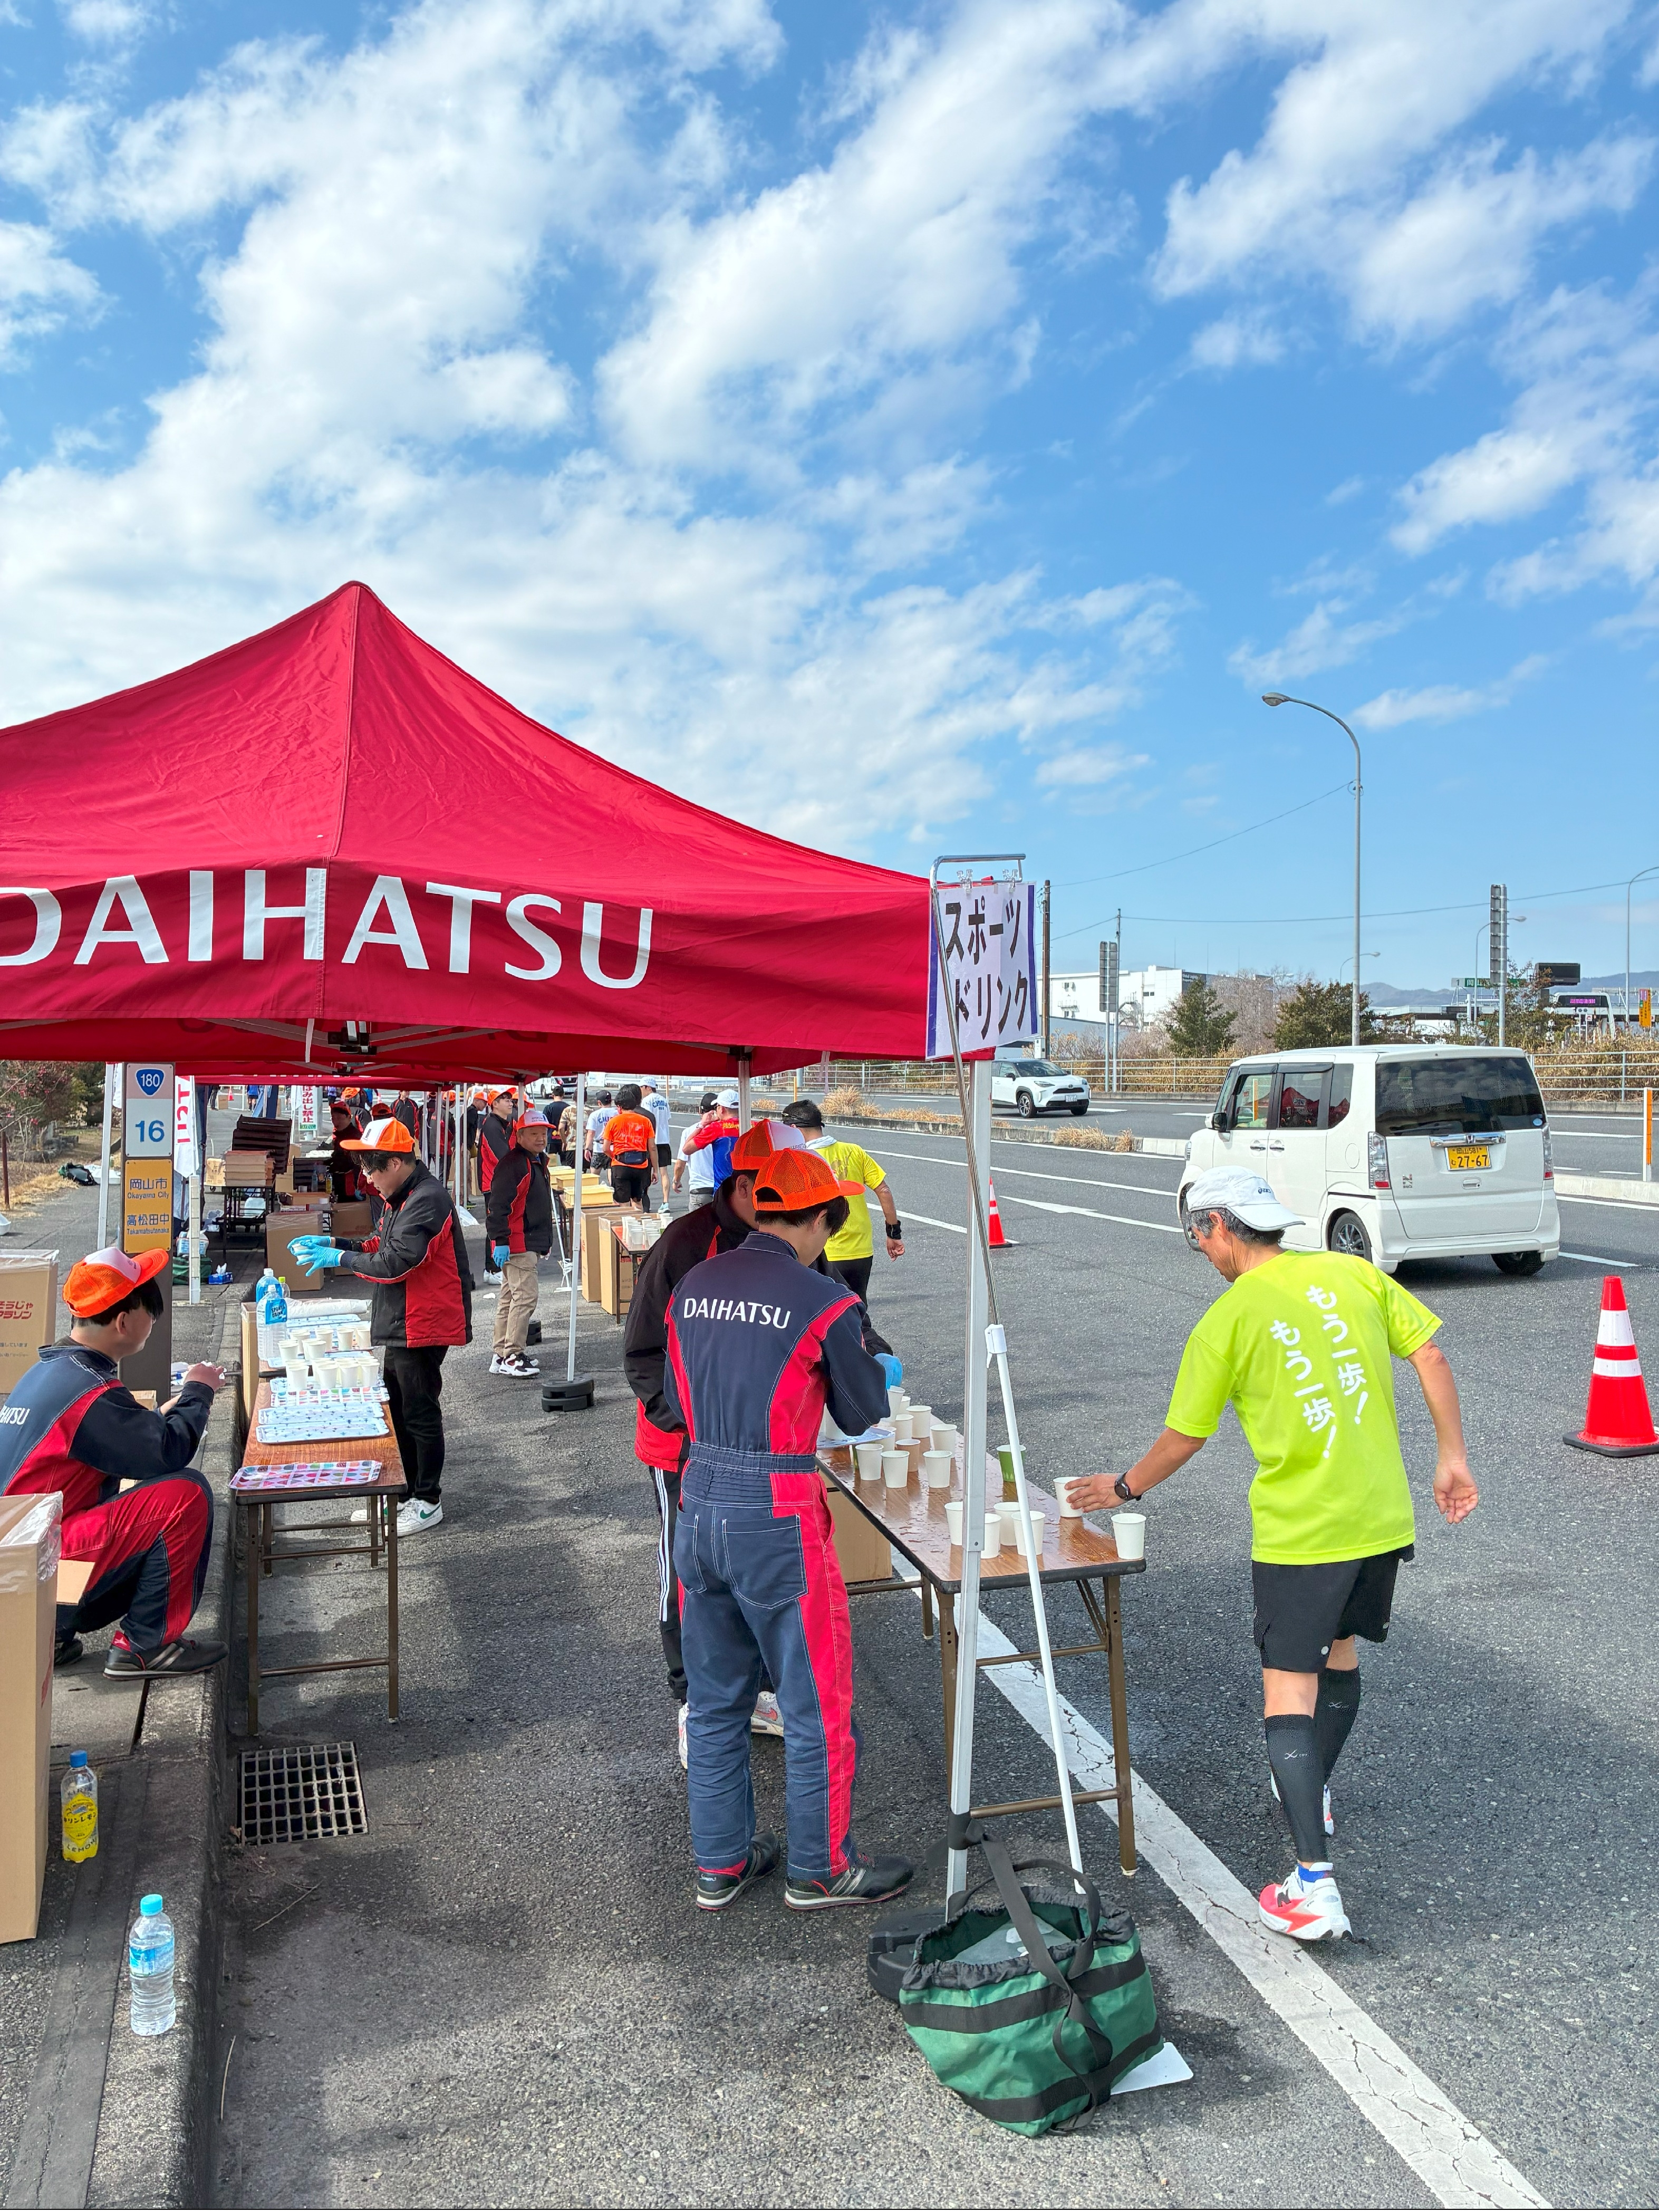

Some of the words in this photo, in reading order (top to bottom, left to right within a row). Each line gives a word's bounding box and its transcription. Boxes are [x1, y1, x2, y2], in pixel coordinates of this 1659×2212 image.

[0, 867, 653, 989] DAIHATSU
[945, 895, 1021, 965] スポーツ
[955, 969, 1028, 1041] ドリンク
[140, 1073, 160, 1087] 180
[135, 1120, 165, 1142] 16
[1457, 1155, 1488, 1168] 27-67
[130, 1178, 168, 1190] 岡山市
[127, 1213, 170, 1226] 高松田中
[683, 1298, 791, 1329] DAIHATSU
[1306, 1285, 1368, 1425] もう一歩！
[1269, 1319, 1337, 1459] もう一歩！
